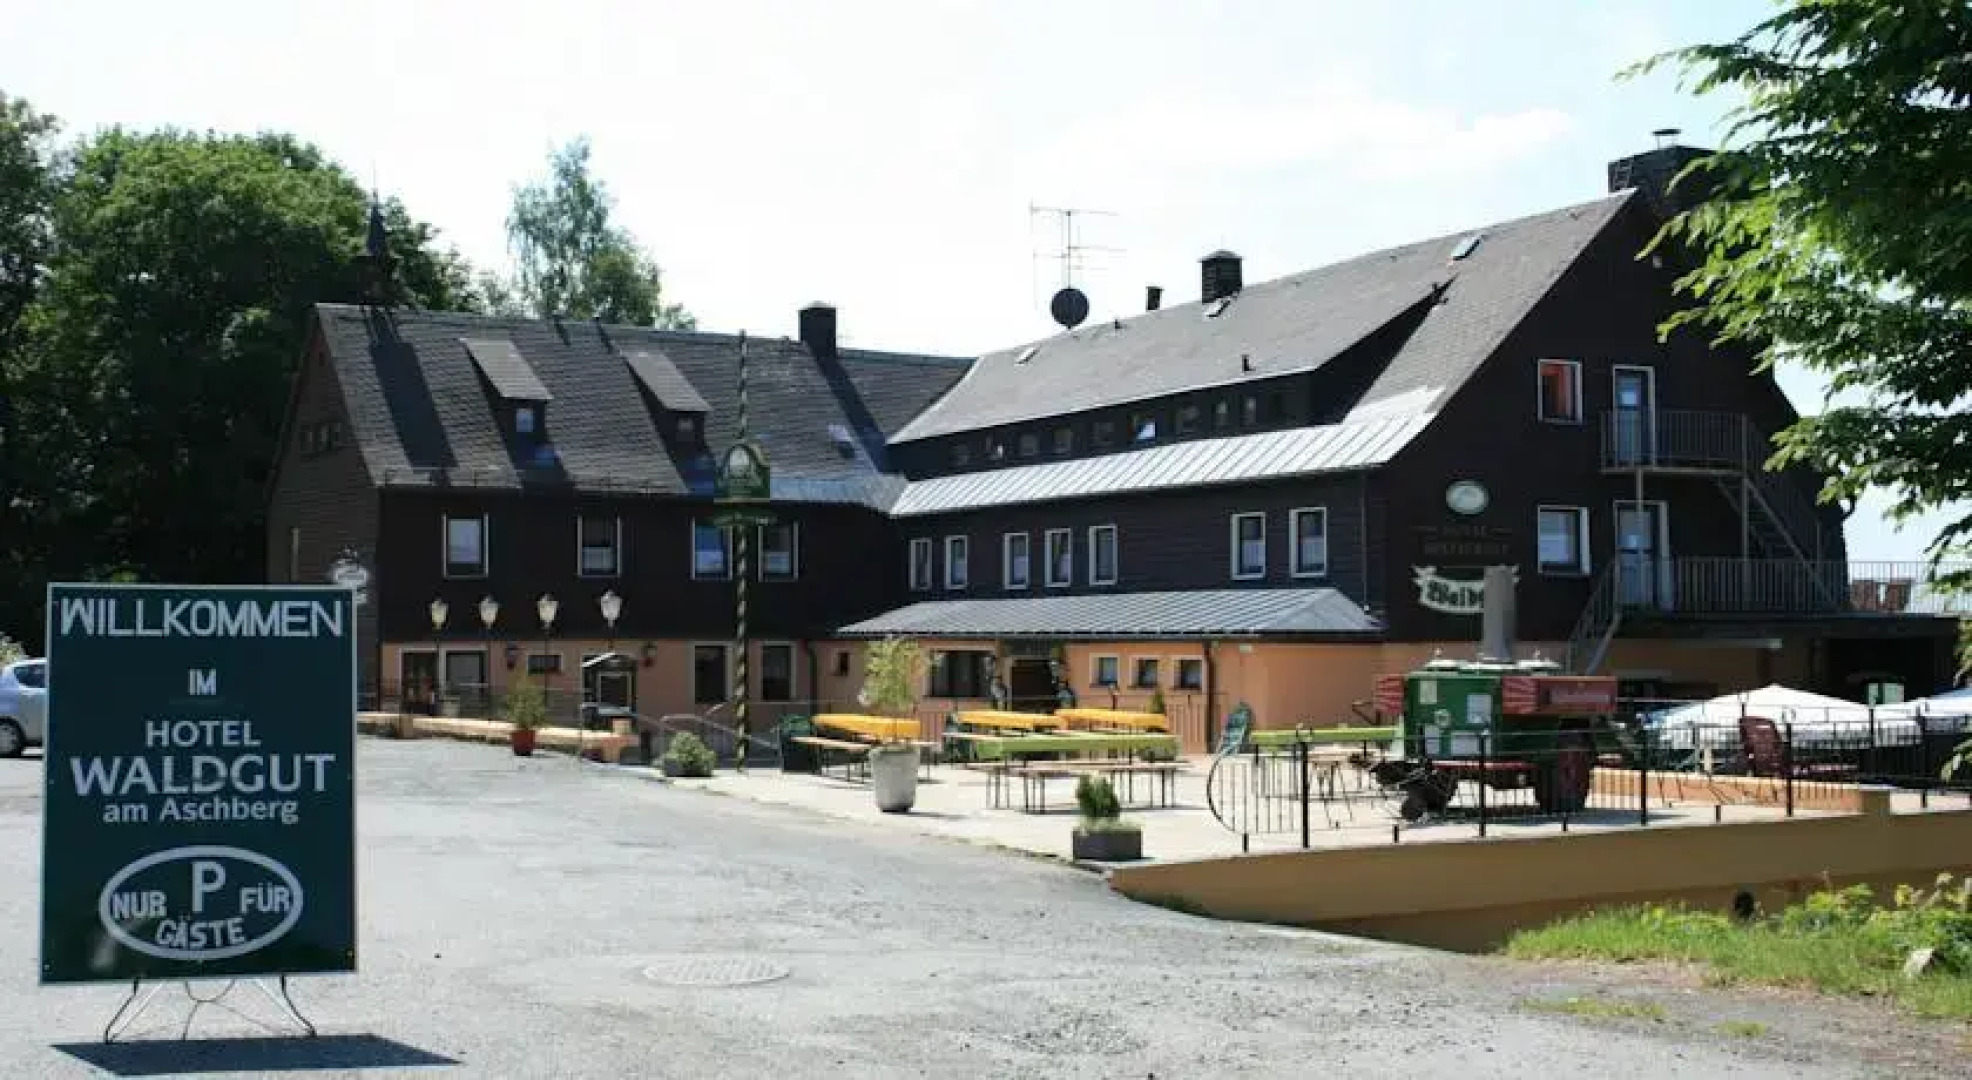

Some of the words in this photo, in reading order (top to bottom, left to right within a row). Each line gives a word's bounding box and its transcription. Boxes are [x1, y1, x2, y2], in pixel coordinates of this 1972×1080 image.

[60, 598, 344, 637] WILLKOMMEN
[188, 669, 217, 695] IM
[146, 720, 261, 748] HOTEL
[70, 754, 336, 796] WALDGUT
[103, 802, 149, 823] am
[159, 798, 298, 824] Aschberg
[112, 891, 167, 920] NUR
[240, 885, 291, 915] FÜR
[191, 861, 226, 913] P
[155, 916, 247, 948] GÄSTE
